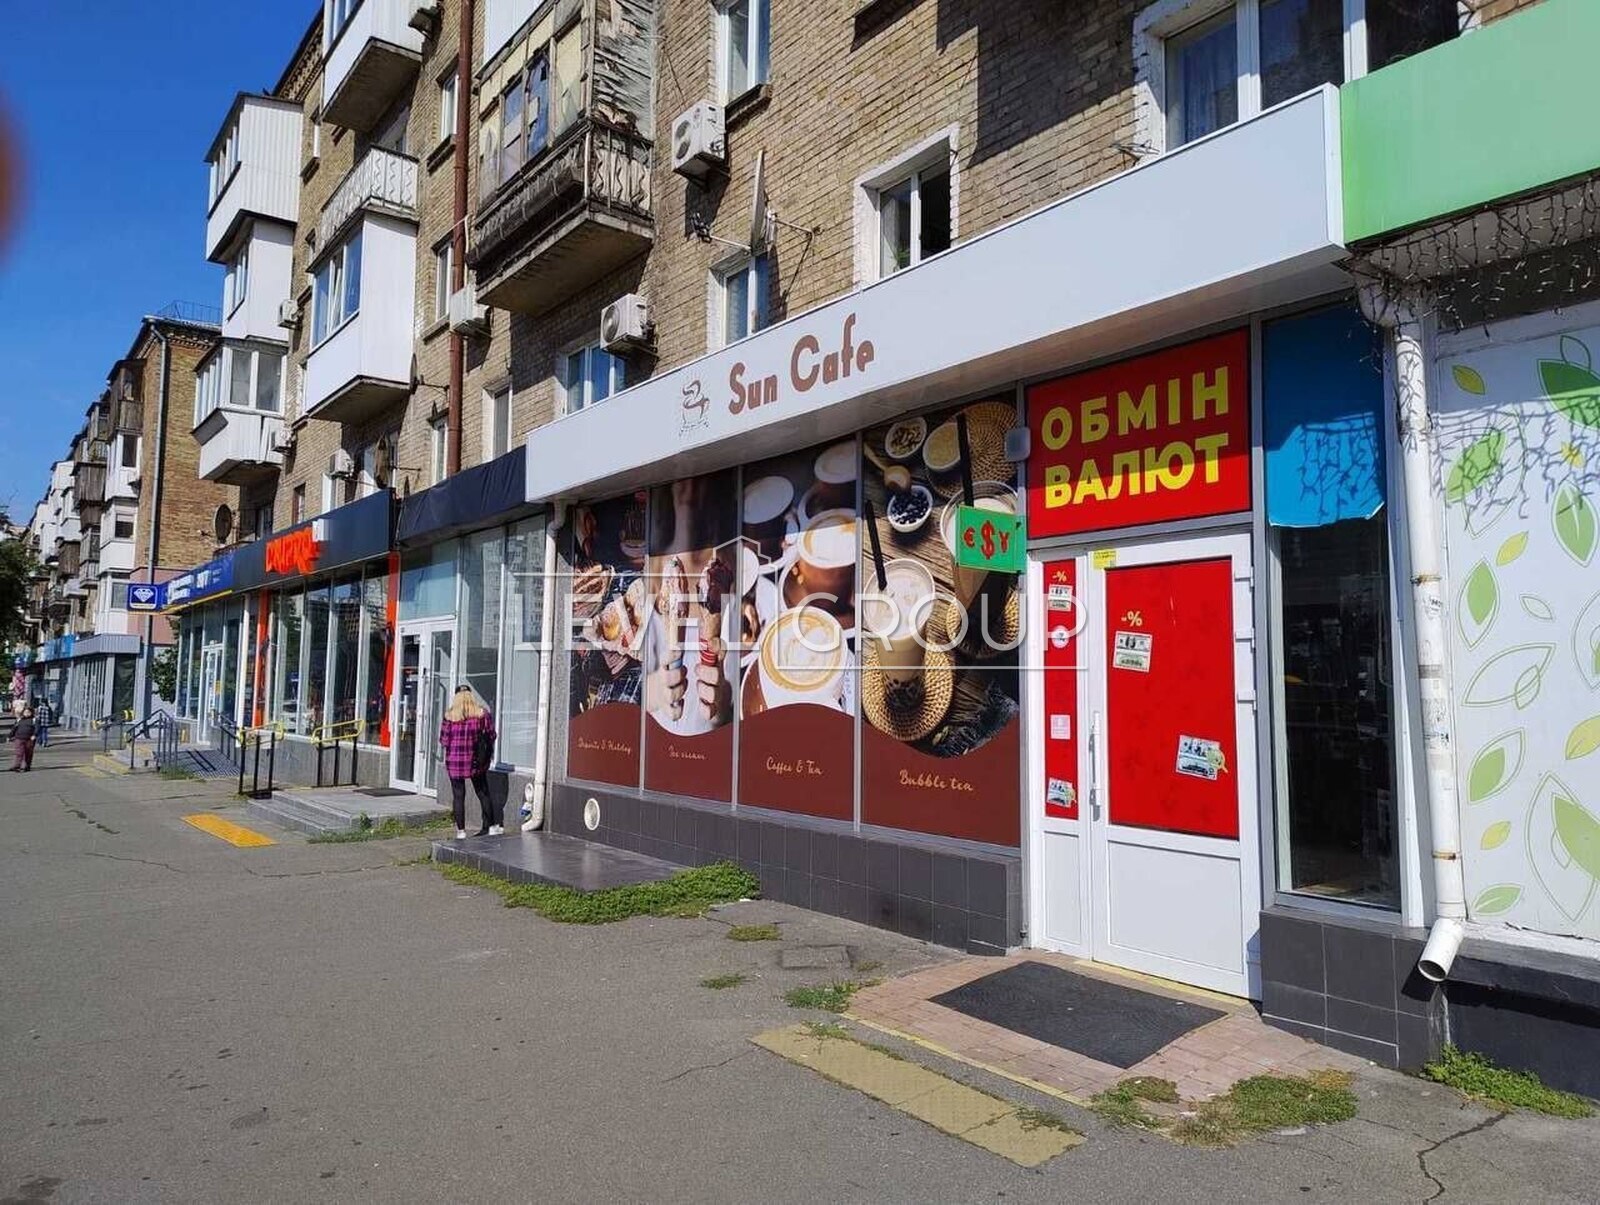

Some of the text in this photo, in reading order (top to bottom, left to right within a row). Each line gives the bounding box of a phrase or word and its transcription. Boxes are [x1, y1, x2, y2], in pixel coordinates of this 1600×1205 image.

[728, 312, 875, 415] Sun Cafe
[1041, 366, 1229, 450] ОБМІН
[1045, 432, 1229, 509] ВАЛЮТ
[766, 756, 792, 775] Coffee
[806, 759, 822, 775] Tea
[900, 769, 974, 792] Bubble tea
